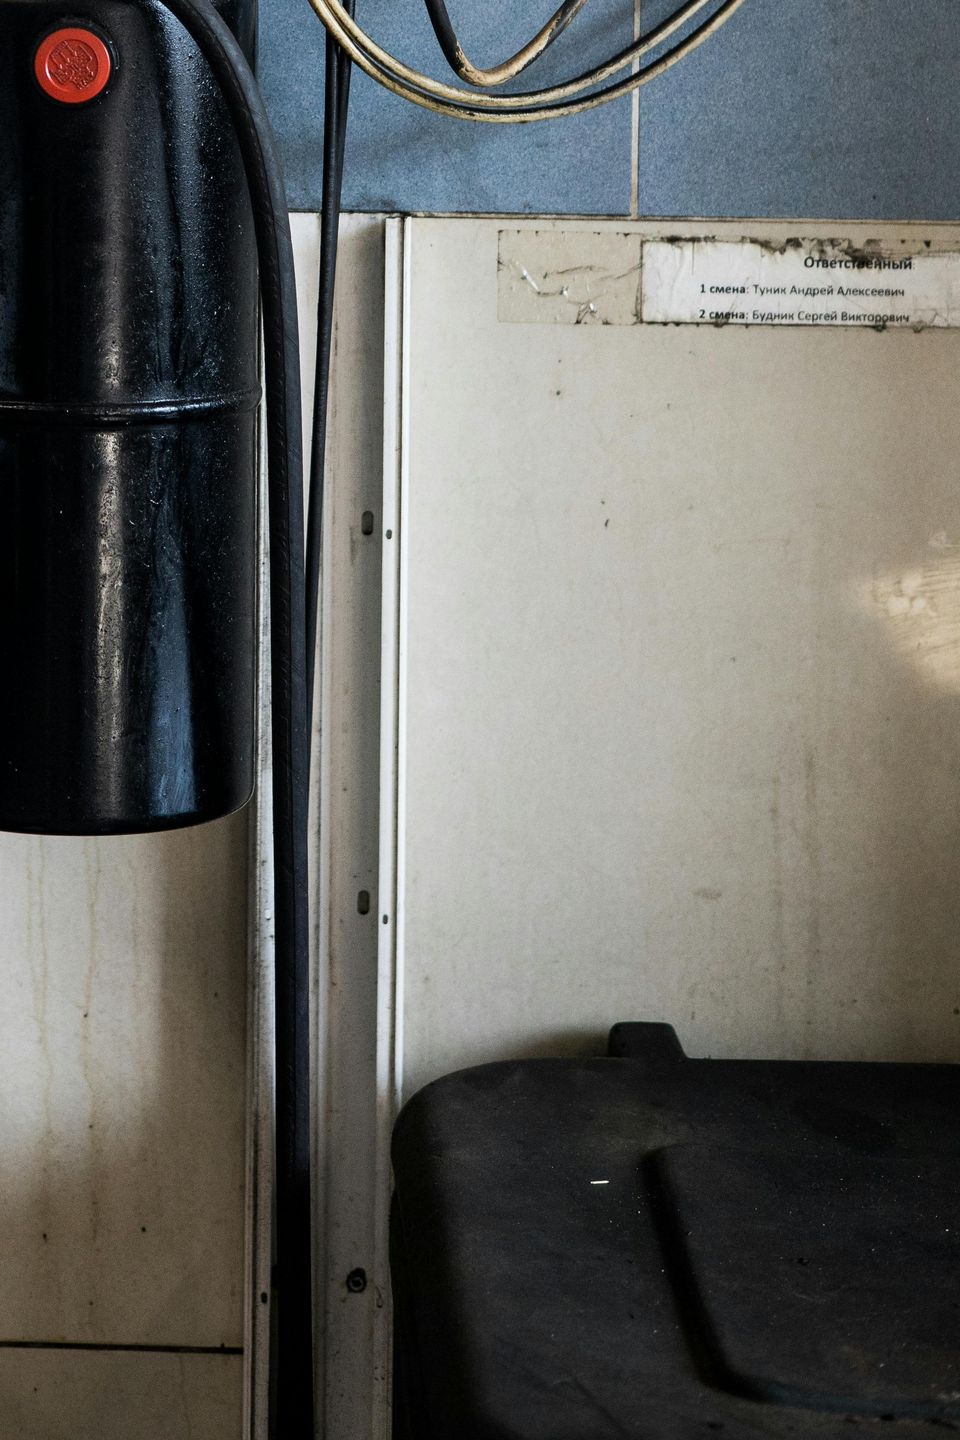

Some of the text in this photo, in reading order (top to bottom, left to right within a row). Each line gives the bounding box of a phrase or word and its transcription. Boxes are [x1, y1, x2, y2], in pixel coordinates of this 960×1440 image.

[700, 284, 905, 297] 1 смена: Туник Андрей Алексеевич
[699, 309, 910, 323] 2 смена: Будник Сергей Викторович
